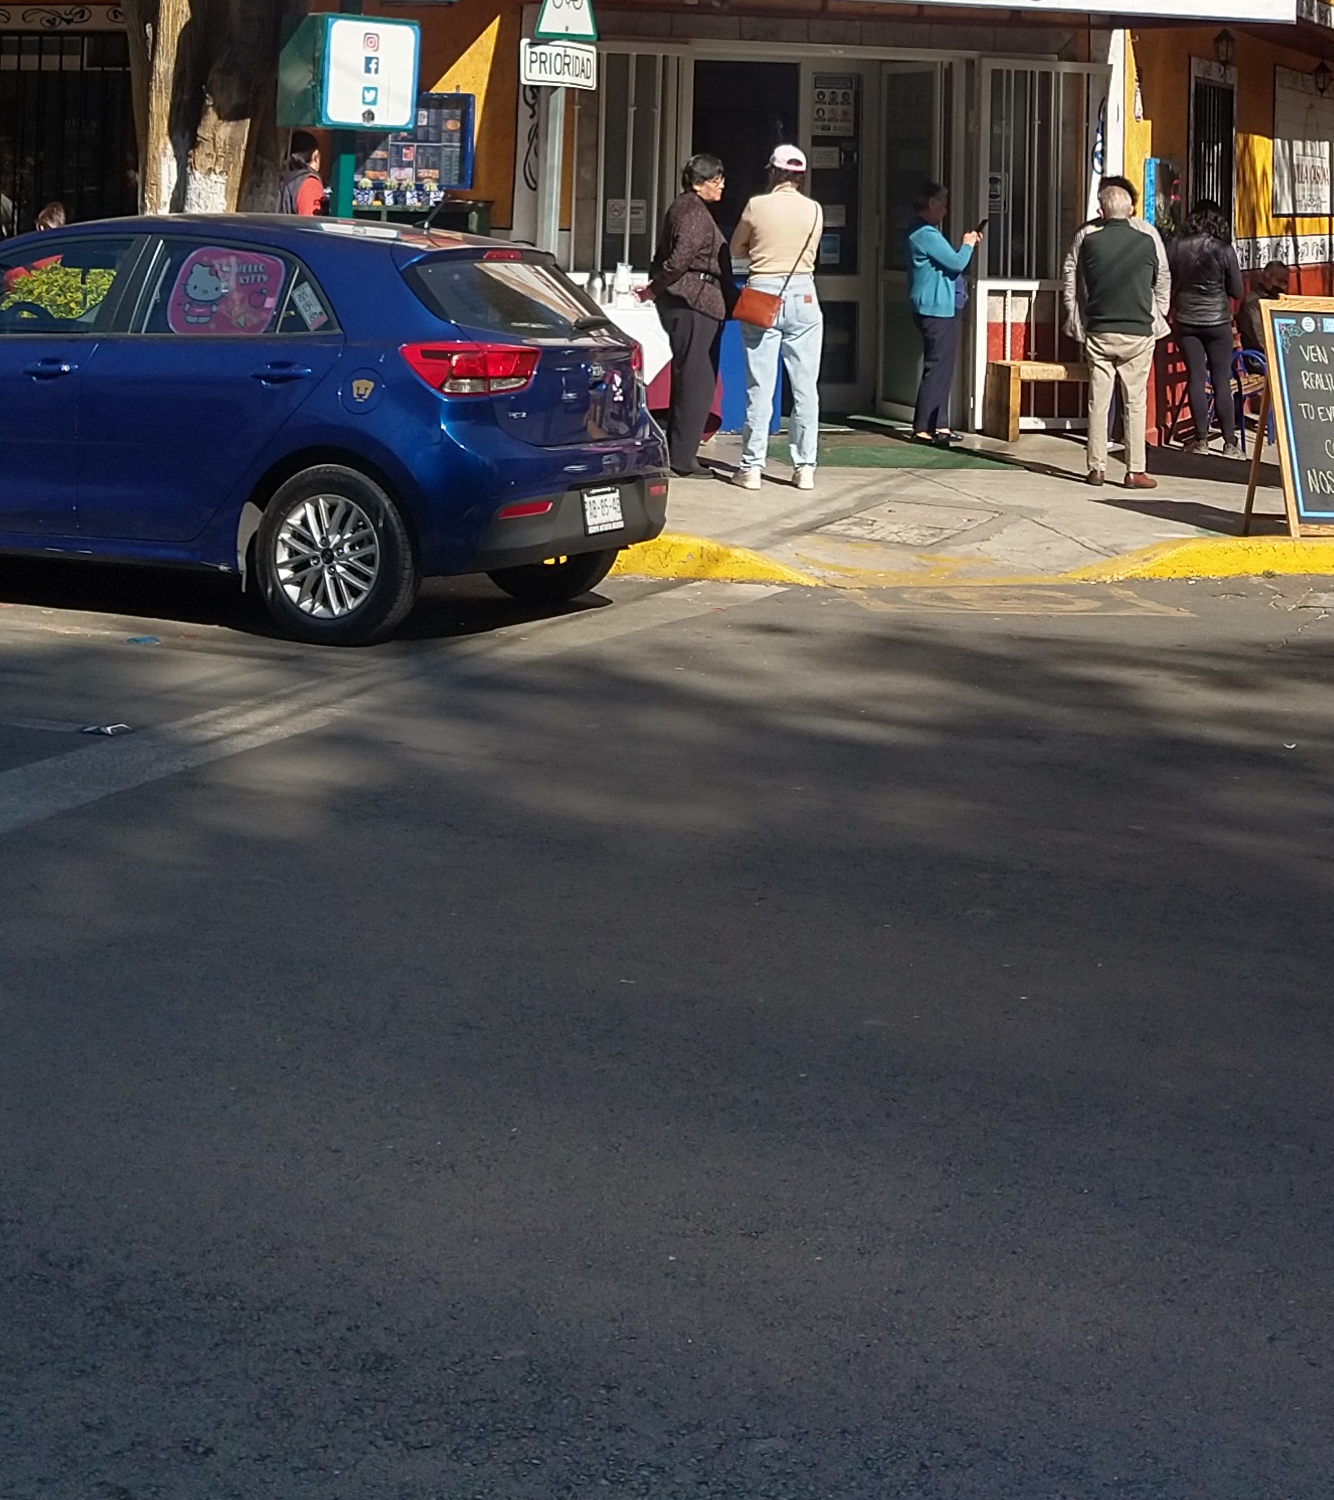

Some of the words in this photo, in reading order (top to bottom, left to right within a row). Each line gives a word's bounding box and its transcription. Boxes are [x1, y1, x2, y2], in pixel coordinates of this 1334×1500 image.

[529, 49, 592, 80] PRIORIDAD
[1299, 344, 1329, 365] VEN
[1298, 403, 1315, 420] TU
